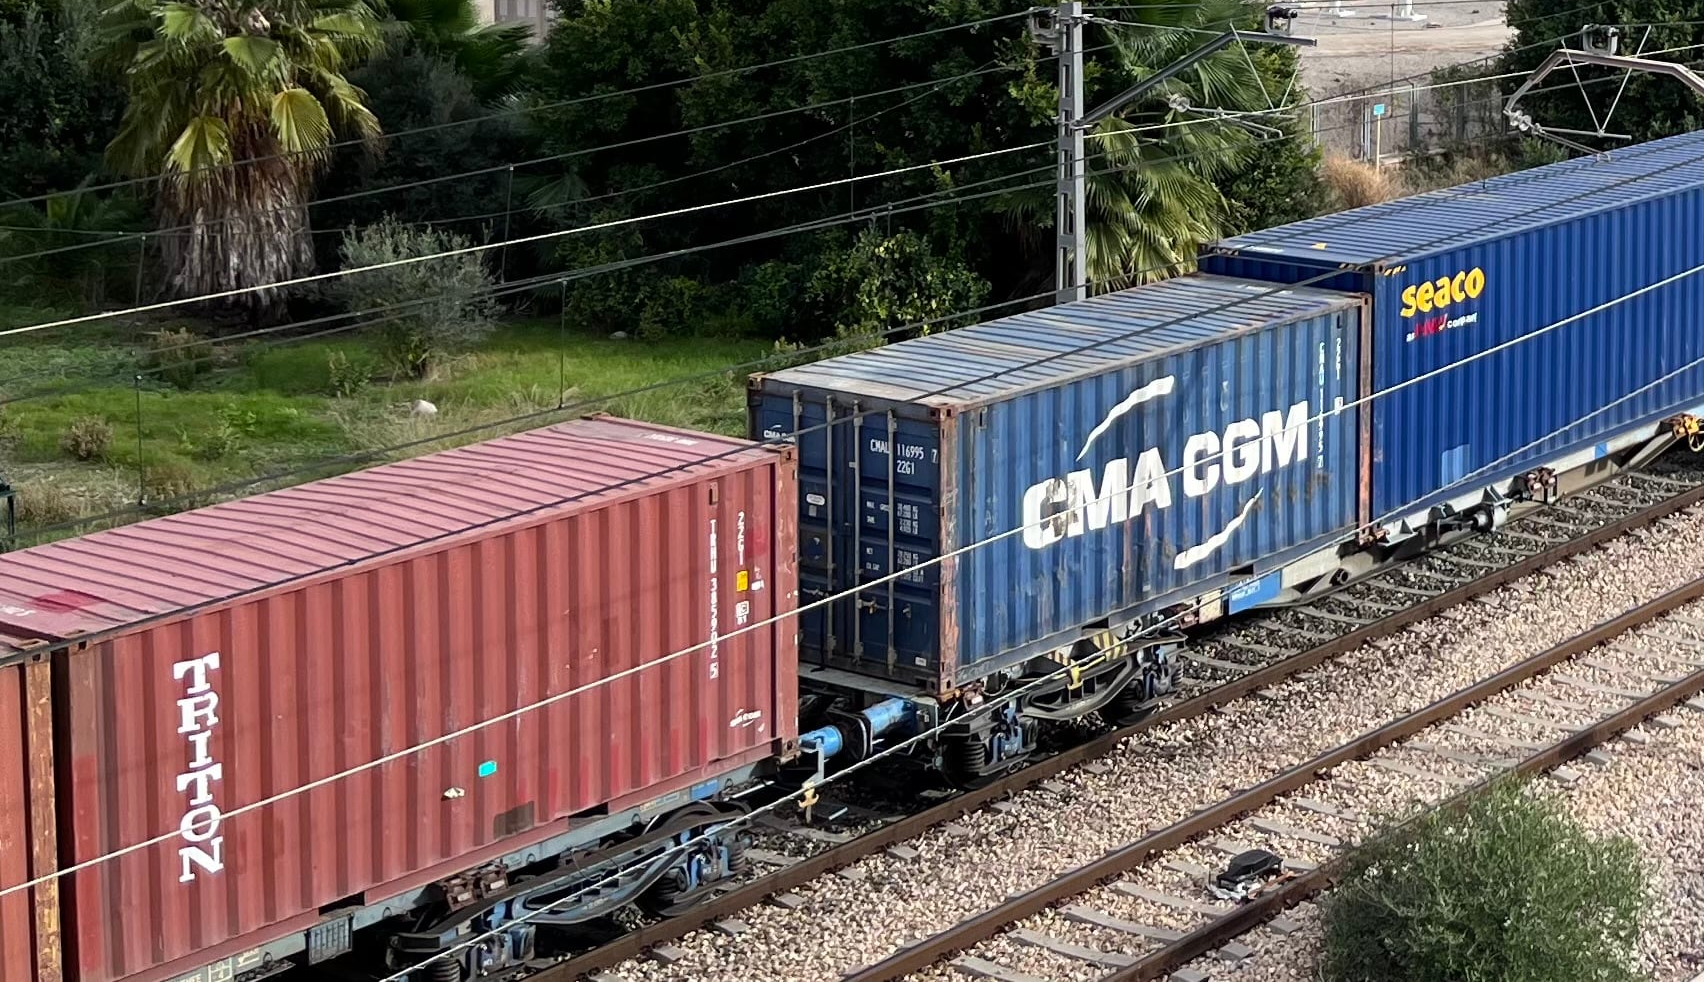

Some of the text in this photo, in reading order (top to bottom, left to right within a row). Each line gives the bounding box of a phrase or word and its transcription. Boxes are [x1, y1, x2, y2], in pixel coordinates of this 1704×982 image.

[1400, 266, 1485, 318] seaco
[896, 443, 924, 460] 116995
[896, 460, 915, 475] 22G1
[1023, 400, 1308, 549] CMA CGM
[737, 511, 745, 566] 22G1
[173, 651, 225, 883] TRITON
